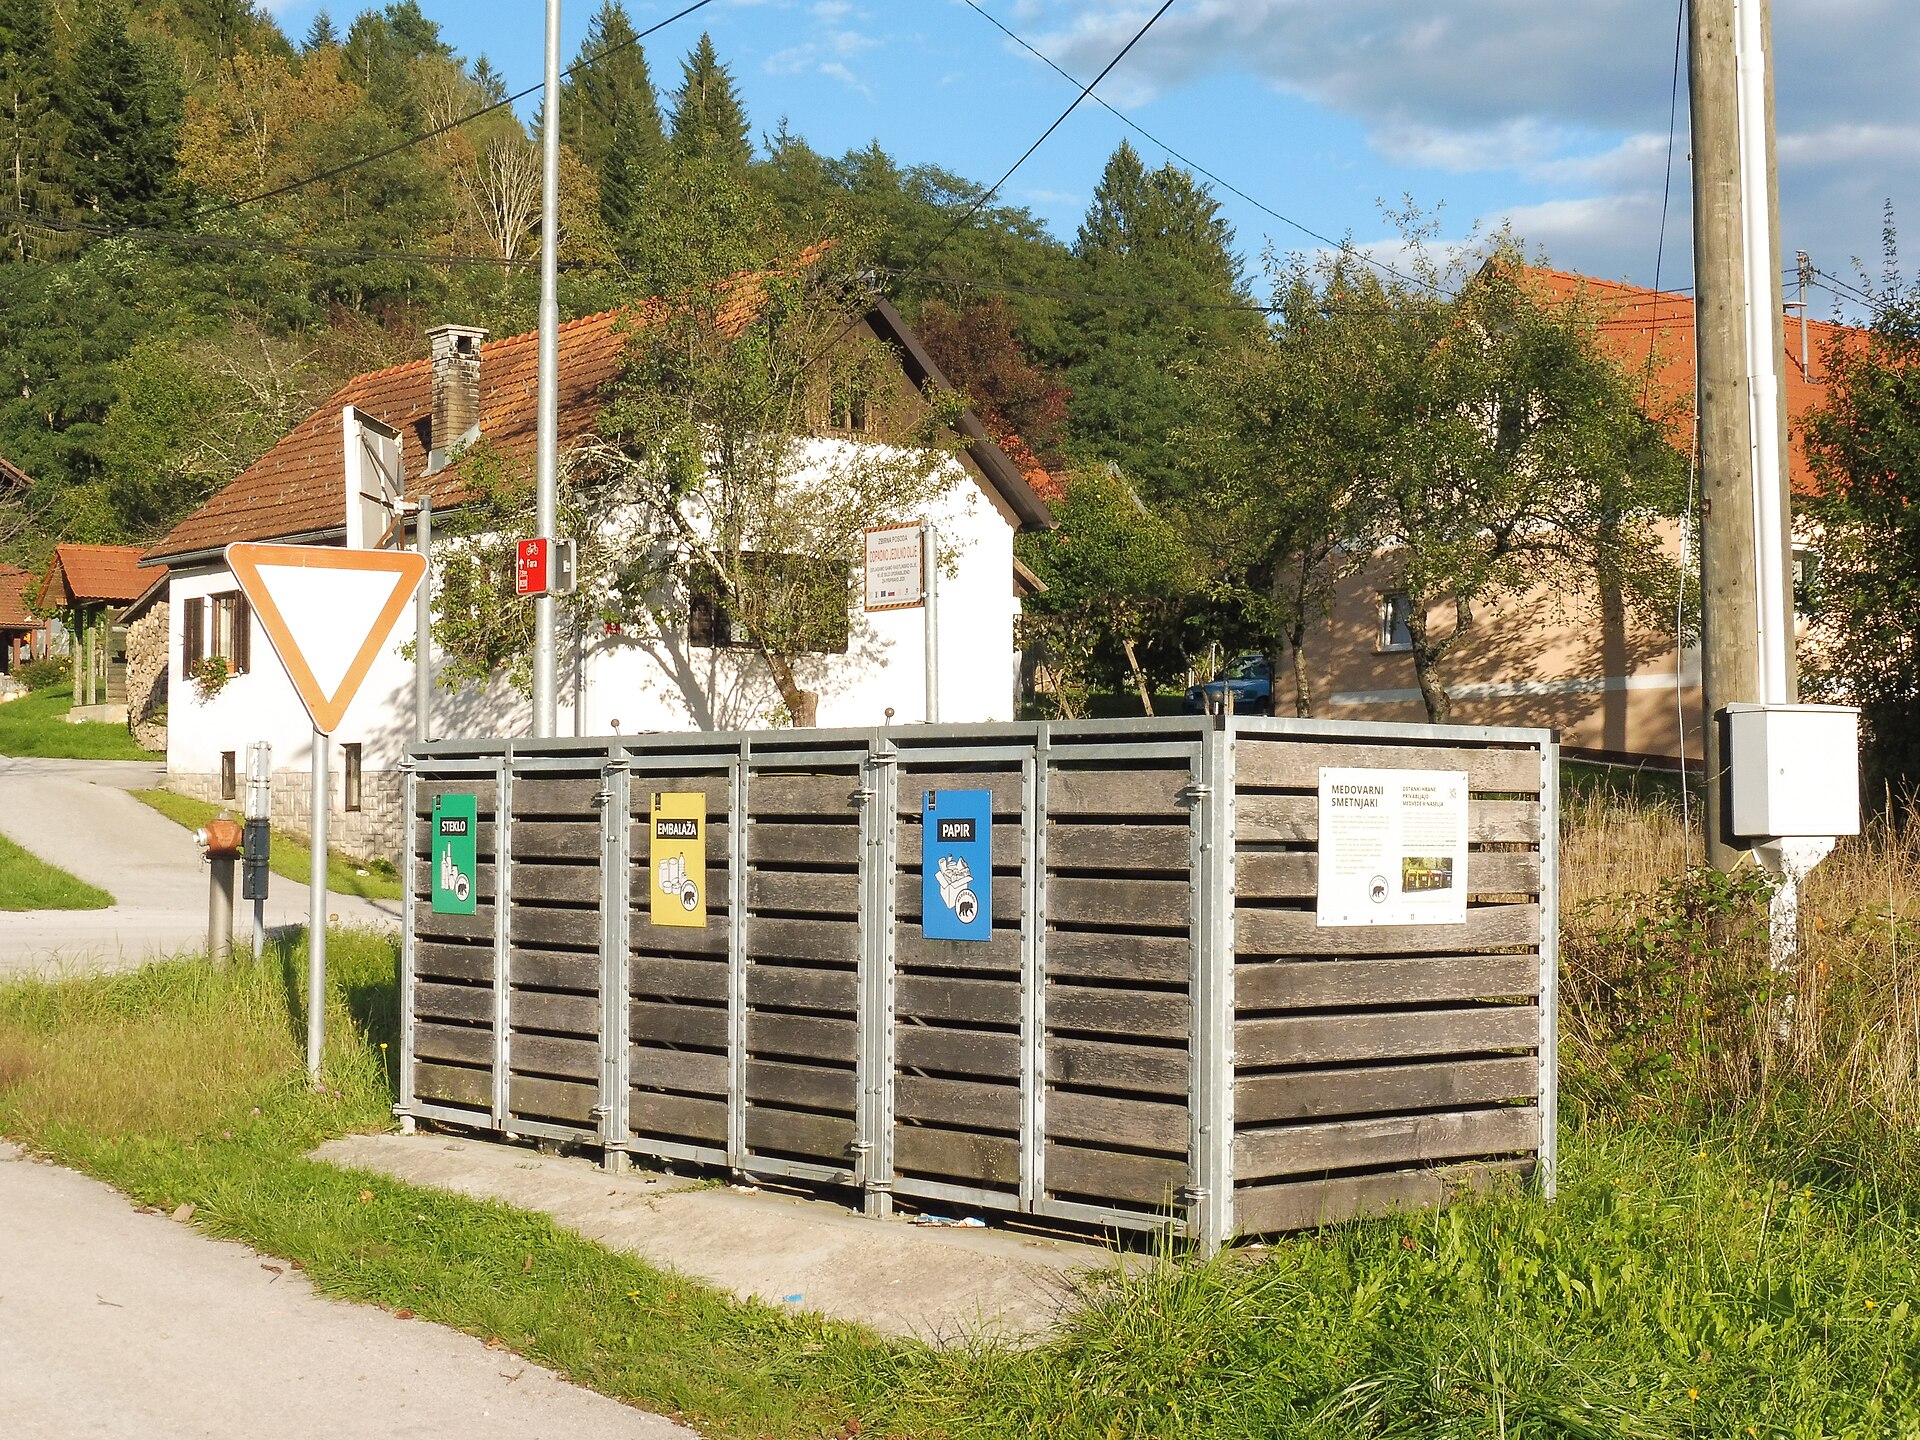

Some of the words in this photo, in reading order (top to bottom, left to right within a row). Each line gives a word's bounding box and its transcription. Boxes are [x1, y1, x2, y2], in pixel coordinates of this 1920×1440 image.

[892, 535, 907, 543] POSODA
[870, 549, 888, 562] ODPADNO
[890, 547, 906, 560] JEDILNO
[907, 545, 917, 558] OLJE
[526, 559, 537, 568] Fara
[1331, 785, 1384, 795] MEDOVARNI
[1331, 797, 1378, 809] SMETNJAKI
[441, 820, 466, 832] STEKLO
[657, 821, 696, 835] EMBALAŽA
[942, 823, 970, 837] PAPIR
